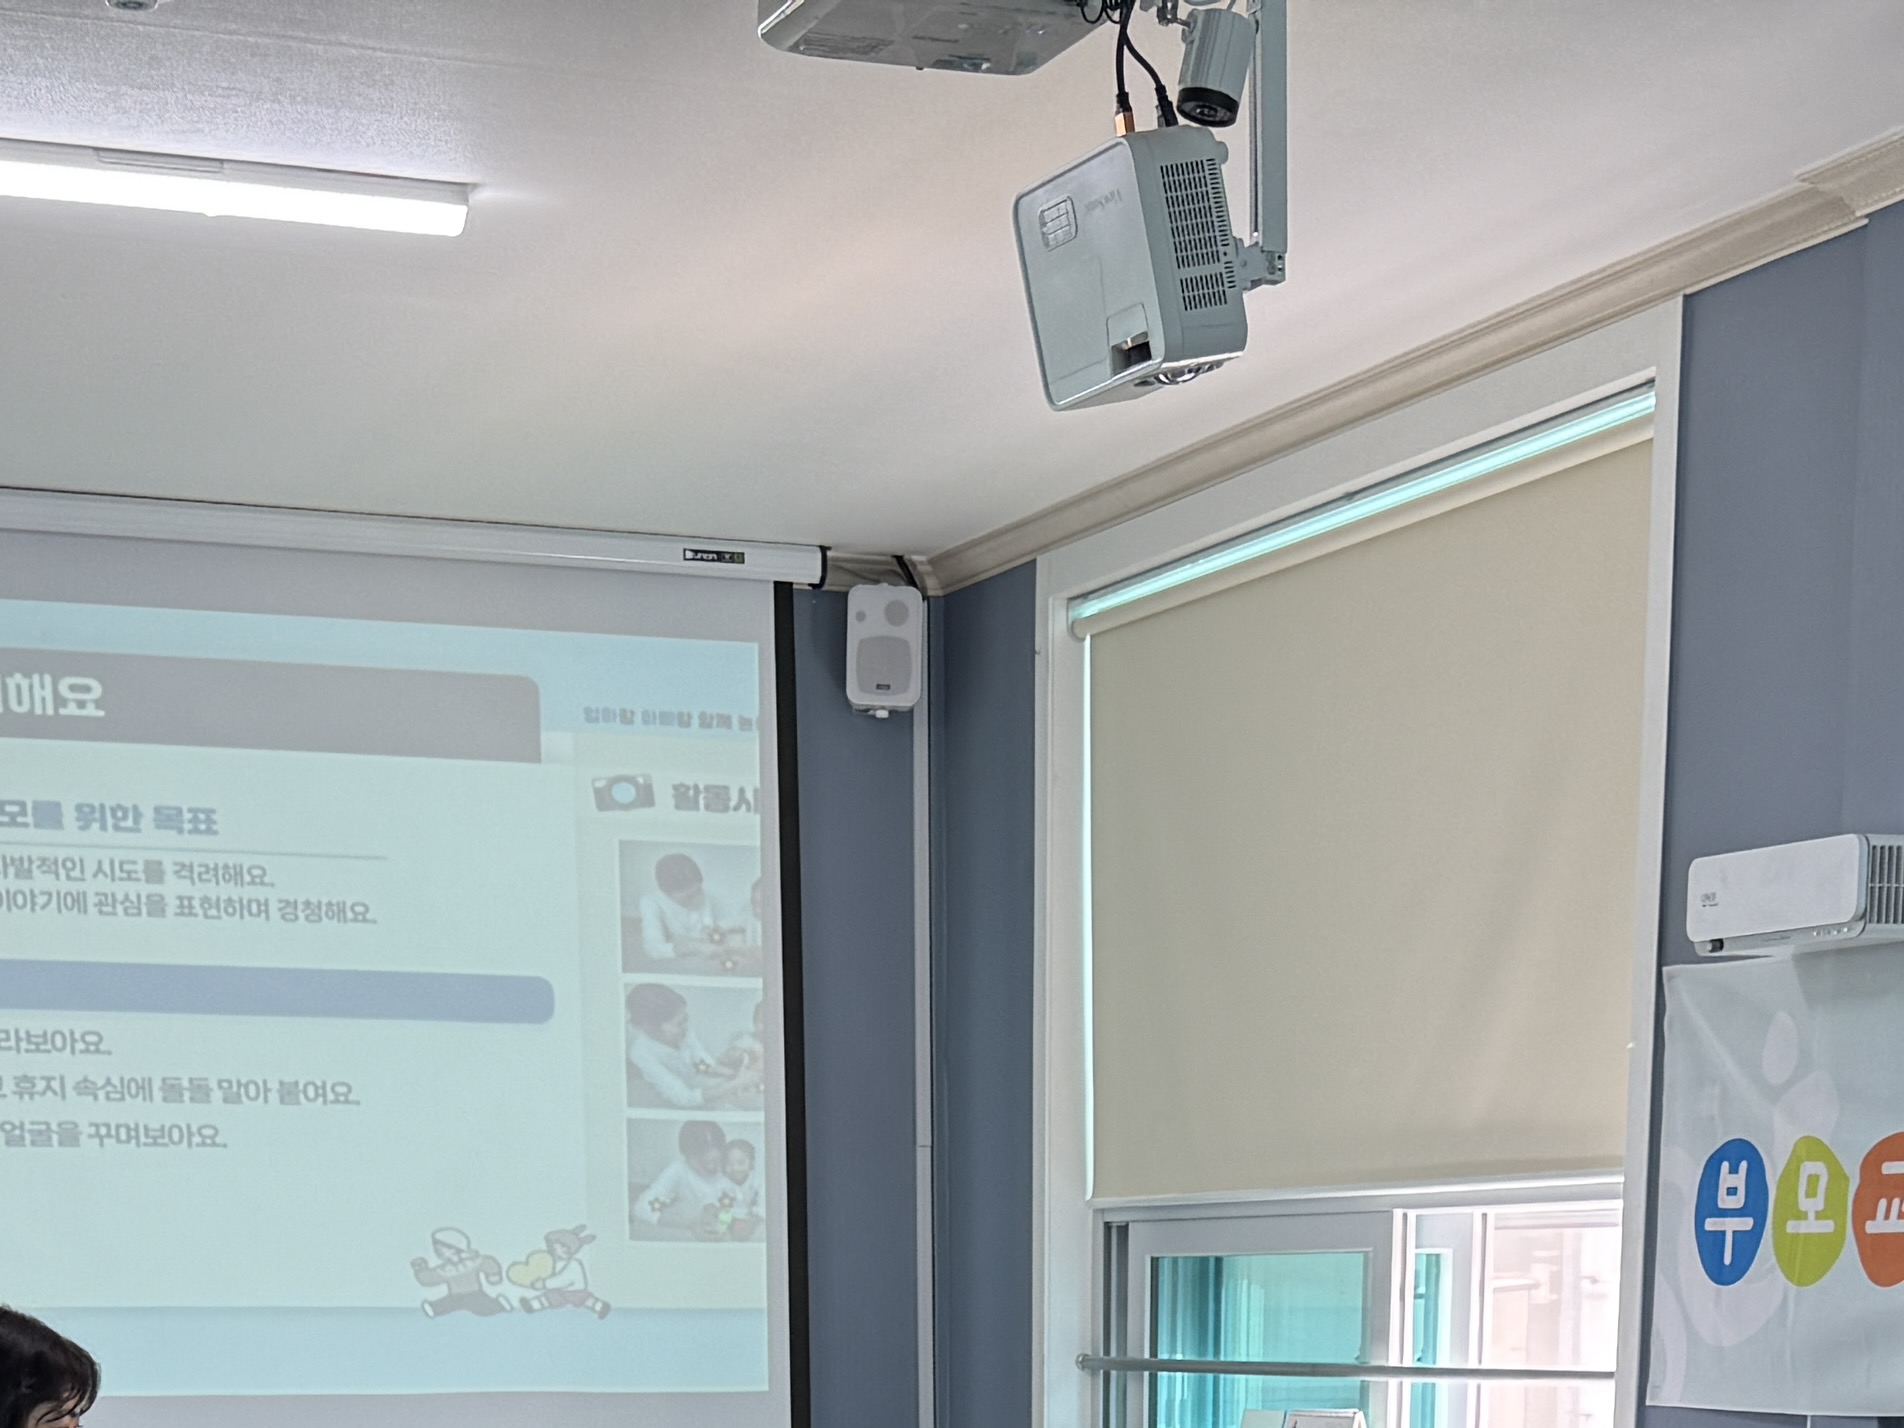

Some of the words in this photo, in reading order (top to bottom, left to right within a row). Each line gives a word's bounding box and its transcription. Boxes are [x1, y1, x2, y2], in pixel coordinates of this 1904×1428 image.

[73, 802, 143, 834] 위한
[153, 804, 219, 836] 목표
[92, 858, 166, 885] 시도를
[172, 861, 276, 888] 격려해요.
[93, 891, 167, 918] 관심을
[173, 893, 270, 922] 표현하며
[277, 897, 378, 925] 경청해요.
[11, 1073, 67, 1102] 휴지
[216, 1077, 272, 1106] 말아
[87, 1121, 228, 1150] 꾸며보아요.
